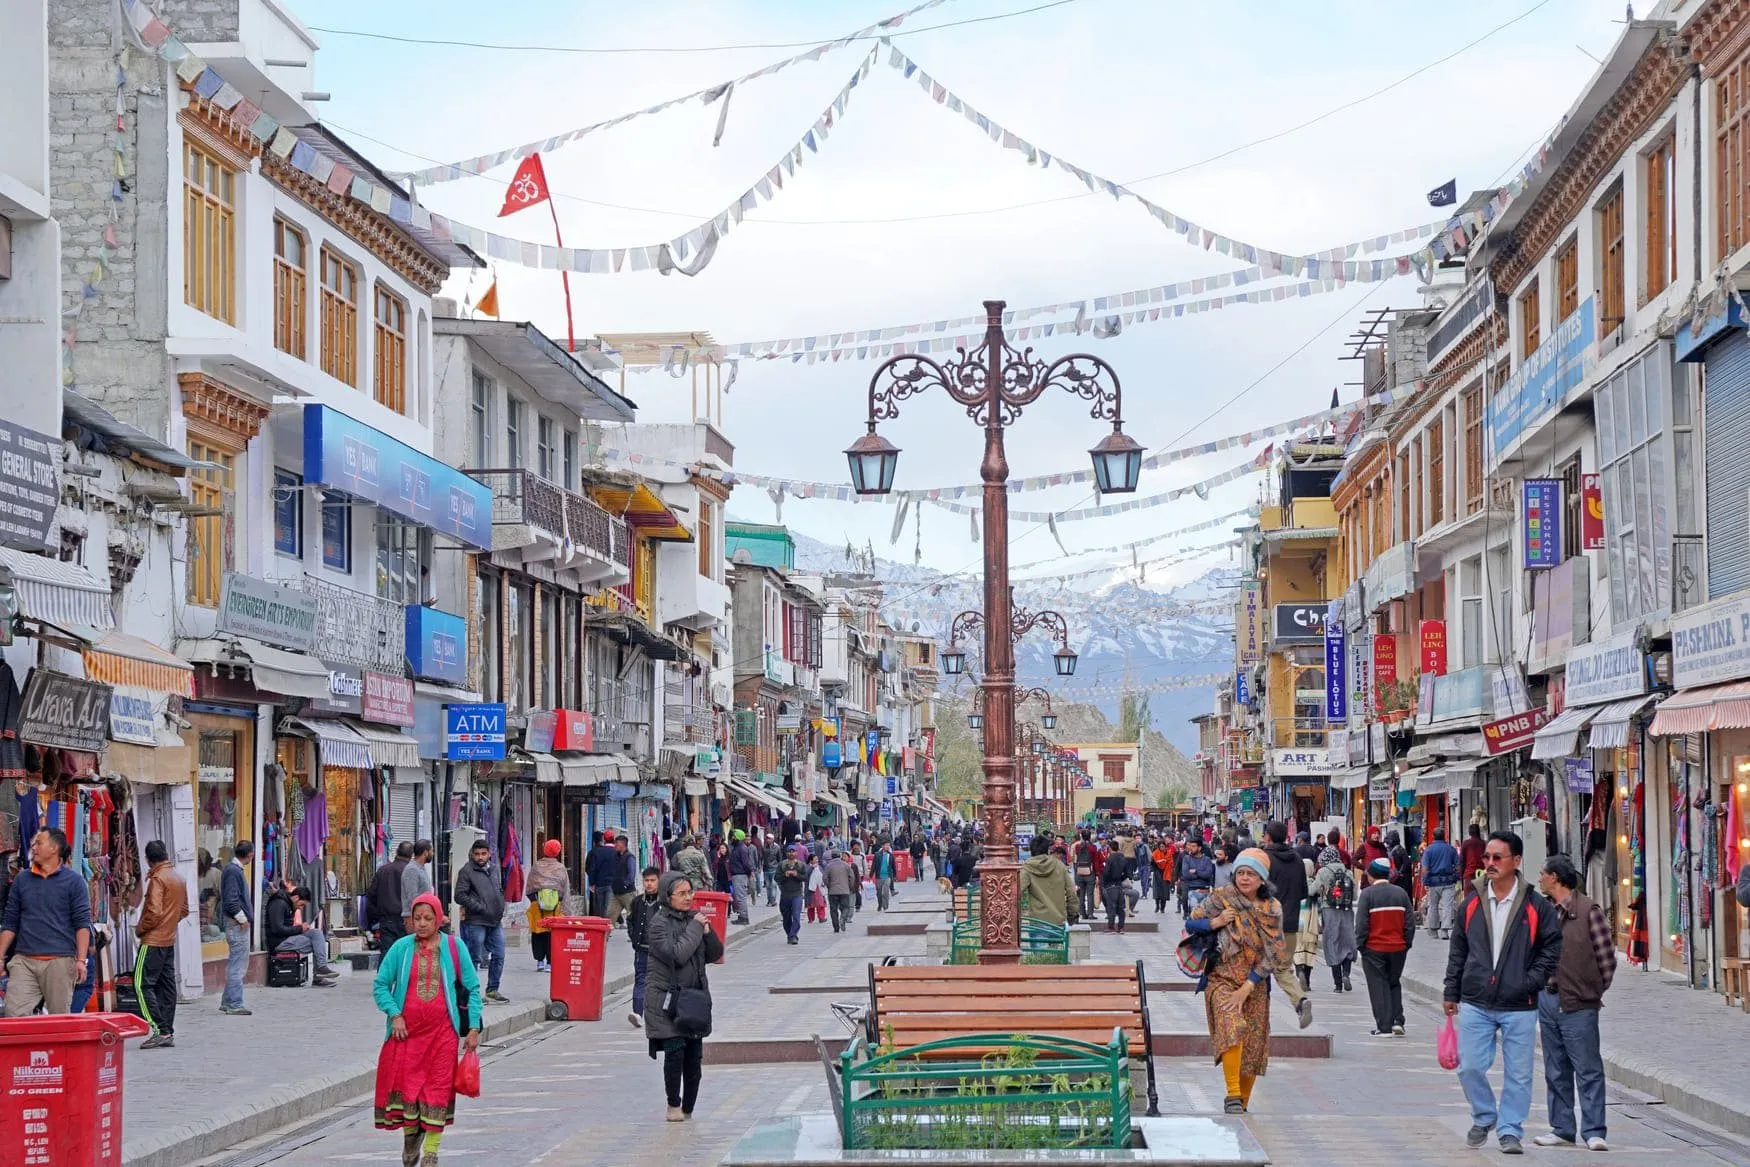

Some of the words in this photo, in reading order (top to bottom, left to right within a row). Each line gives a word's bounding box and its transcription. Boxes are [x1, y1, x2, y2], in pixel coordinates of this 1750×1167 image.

[1540, 309, 1582, 372] INSTITUTES
[2, 449, 32, 482] GENERAL
[33, 460, 54, 489] STORE
[345, 445, 357, 467] YES
[361, 451, 377, 476] BANK
[1543, 487, 1551, 561] RESTAURANT
[1590, 537, 1605, 548] LE
[229, 591, 267, 621] EVERGREEN
[1247, 591, 1256, 650] HIMALAYAN
[1424, 632, 1441, 640] LEH
[1675, 617, 1736, 659] PASHMINA
[331, 670, 362, 697] Cashmer
[1239, 674, 1249, 703] CAFE
[1332, 679, 1340, 715] LOTUS
[455, 715, 498, 731] ATM
[1499, 717, 1530, 737] PNB
[1534, 711, 1551, 726] AT
[1282, 753, 1317, 763] ART
[13, 1065, 63, 1077] Nilkamal
